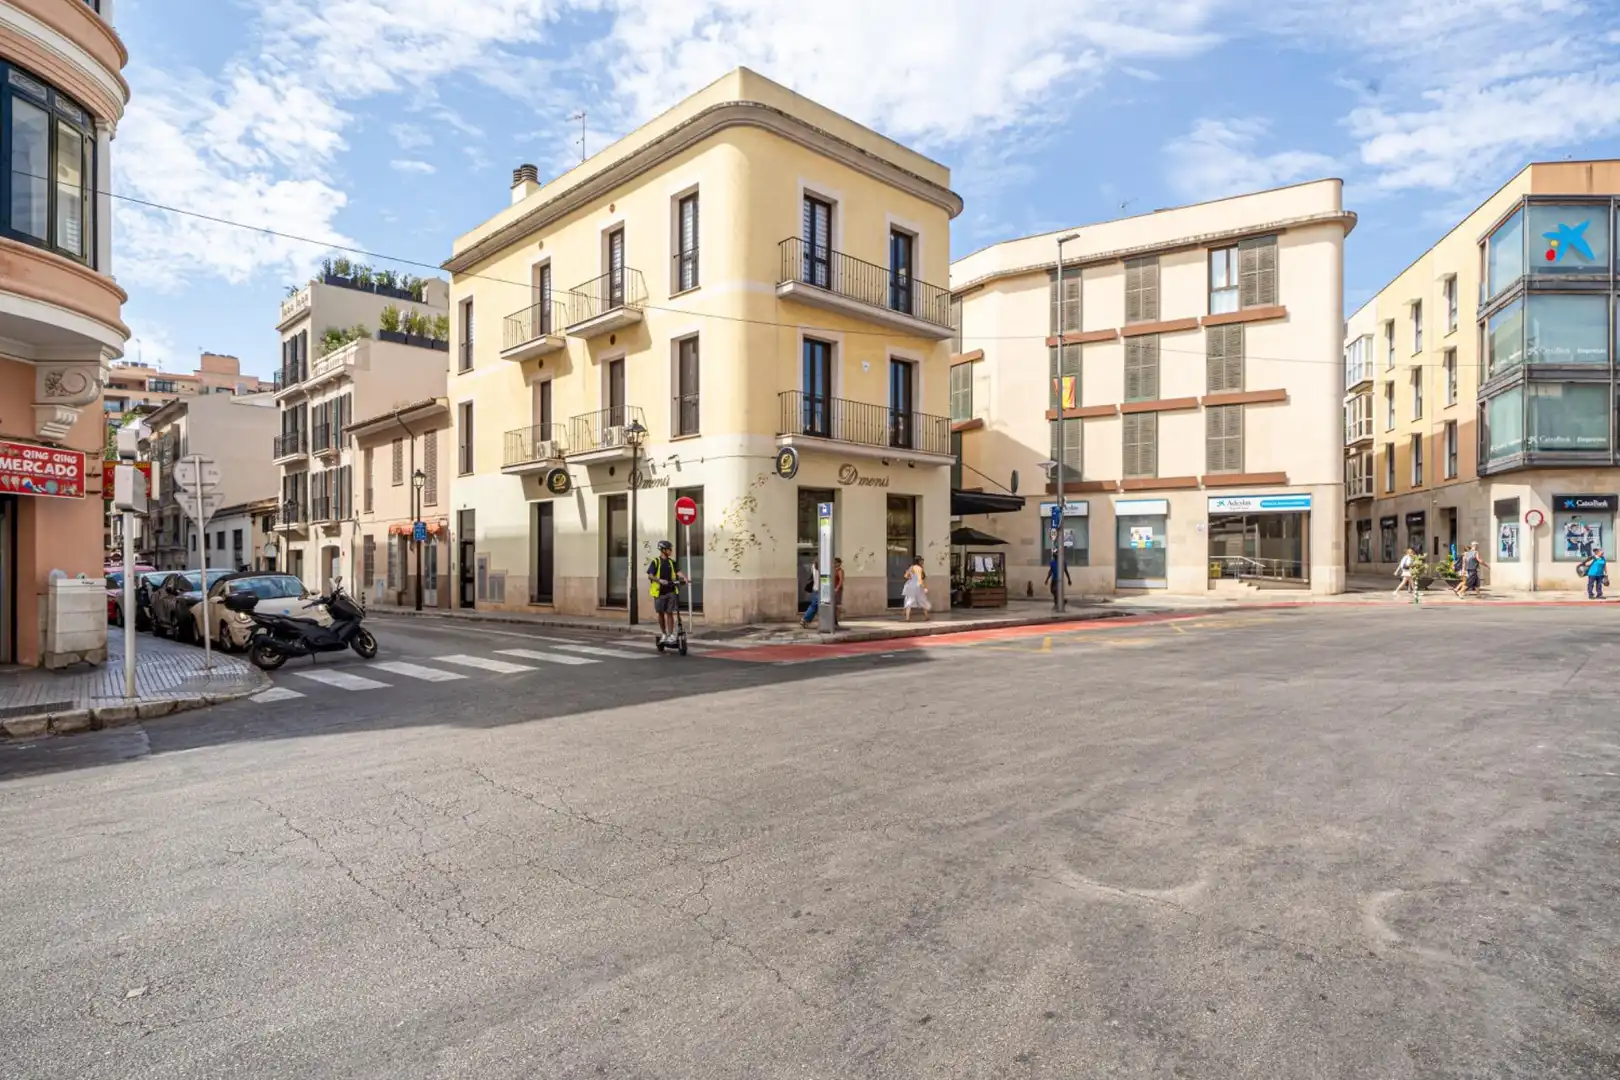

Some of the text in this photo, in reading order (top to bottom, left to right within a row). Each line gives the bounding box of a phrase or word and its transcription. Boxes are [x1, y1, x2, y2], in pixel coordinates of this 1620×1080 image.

[22, 449, 77, 464] QING QING
[0, 457, 78, 477] MERCADO
[1575, 499, 1609, 508] CaixaBank
